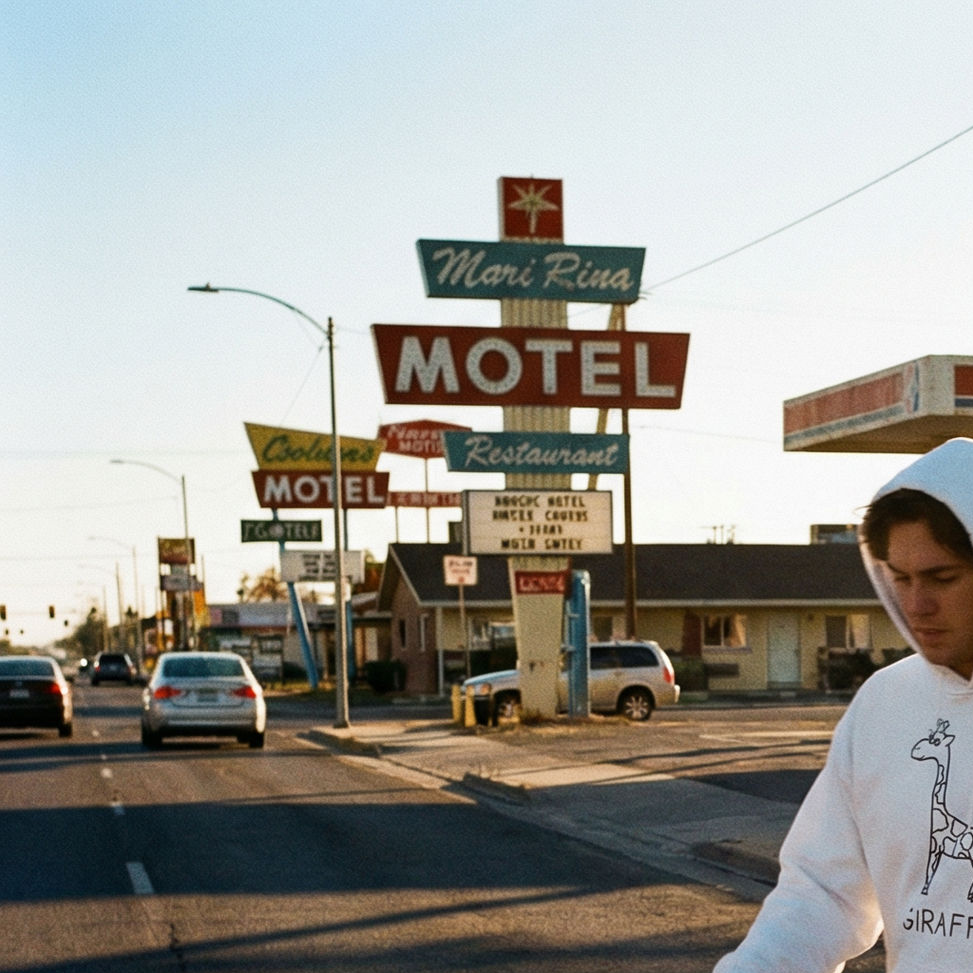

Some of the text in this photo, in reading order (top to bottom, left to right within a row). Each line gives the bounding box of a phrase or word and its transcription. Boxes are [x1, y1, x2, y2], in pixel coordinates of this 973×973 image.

[432, 247, 634, 292] Mari Rina
[395, 336, 677, 397] MOTEL
[465, 435, 618, 467] Restaurant
[264, 474, 385, 503] MOTEL
